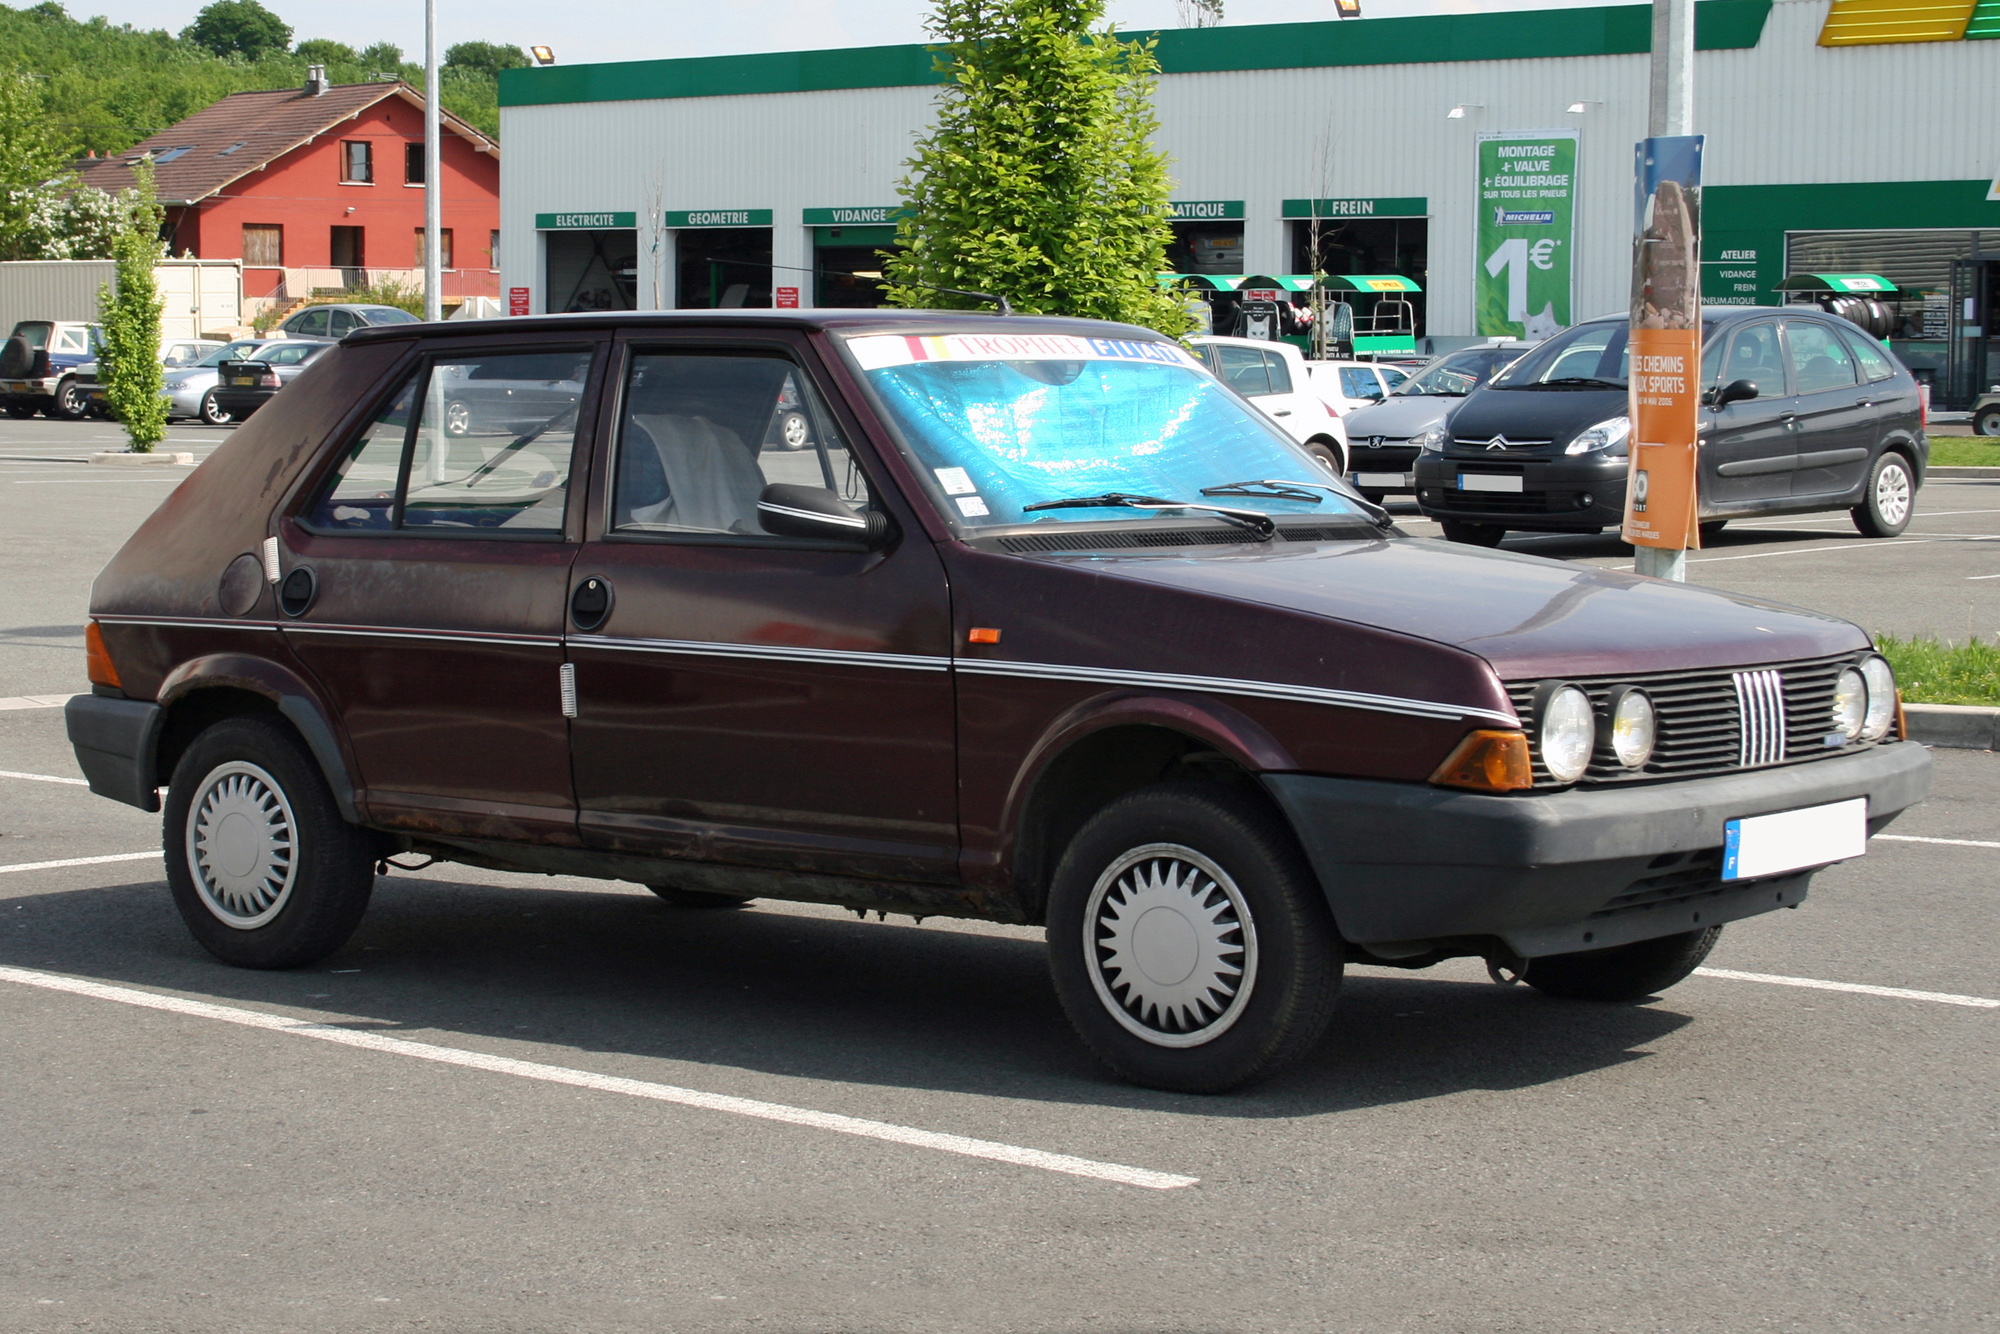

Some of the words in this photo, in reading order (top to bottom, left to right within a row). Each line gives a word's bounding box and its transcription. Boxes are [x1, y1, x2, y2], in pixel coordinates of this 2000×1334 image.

[1498, 145, 1556, 158] MONTAGE
[1513, 160, 1550, 172] VALVE
[1494, 173, 1569, 187] ÉQUILIBRAGE
[1483, 190, 1499, 199] SUR
[1500, 190, 1520, 199] TOUS
[1522, 190, 1537, 198] LES
[1539, 189, 1567, 198] PNEUS
[1332, 200, 1373, 215] FREIN
[556, 214, 614, 226] ELECTRICITE
[688, 211, 748, 225] GEOMETRIE
[832, 208, 886, 222] VIDANGE
[1505, 213, 1552, 221] MICHELIN
[1720, 249, 1756, 260] ATELIER
[1719, 270, 1757, 279] VIDANGE
[1733, 283, 1756, 292] FREIN
[1095, 339, 1182, 363] FIAT
[1644, 355, 1685, 374] CHEMINS
[1648, 376, 1686, 394] SPORTS
[1728, 856, 1736, 871] F
